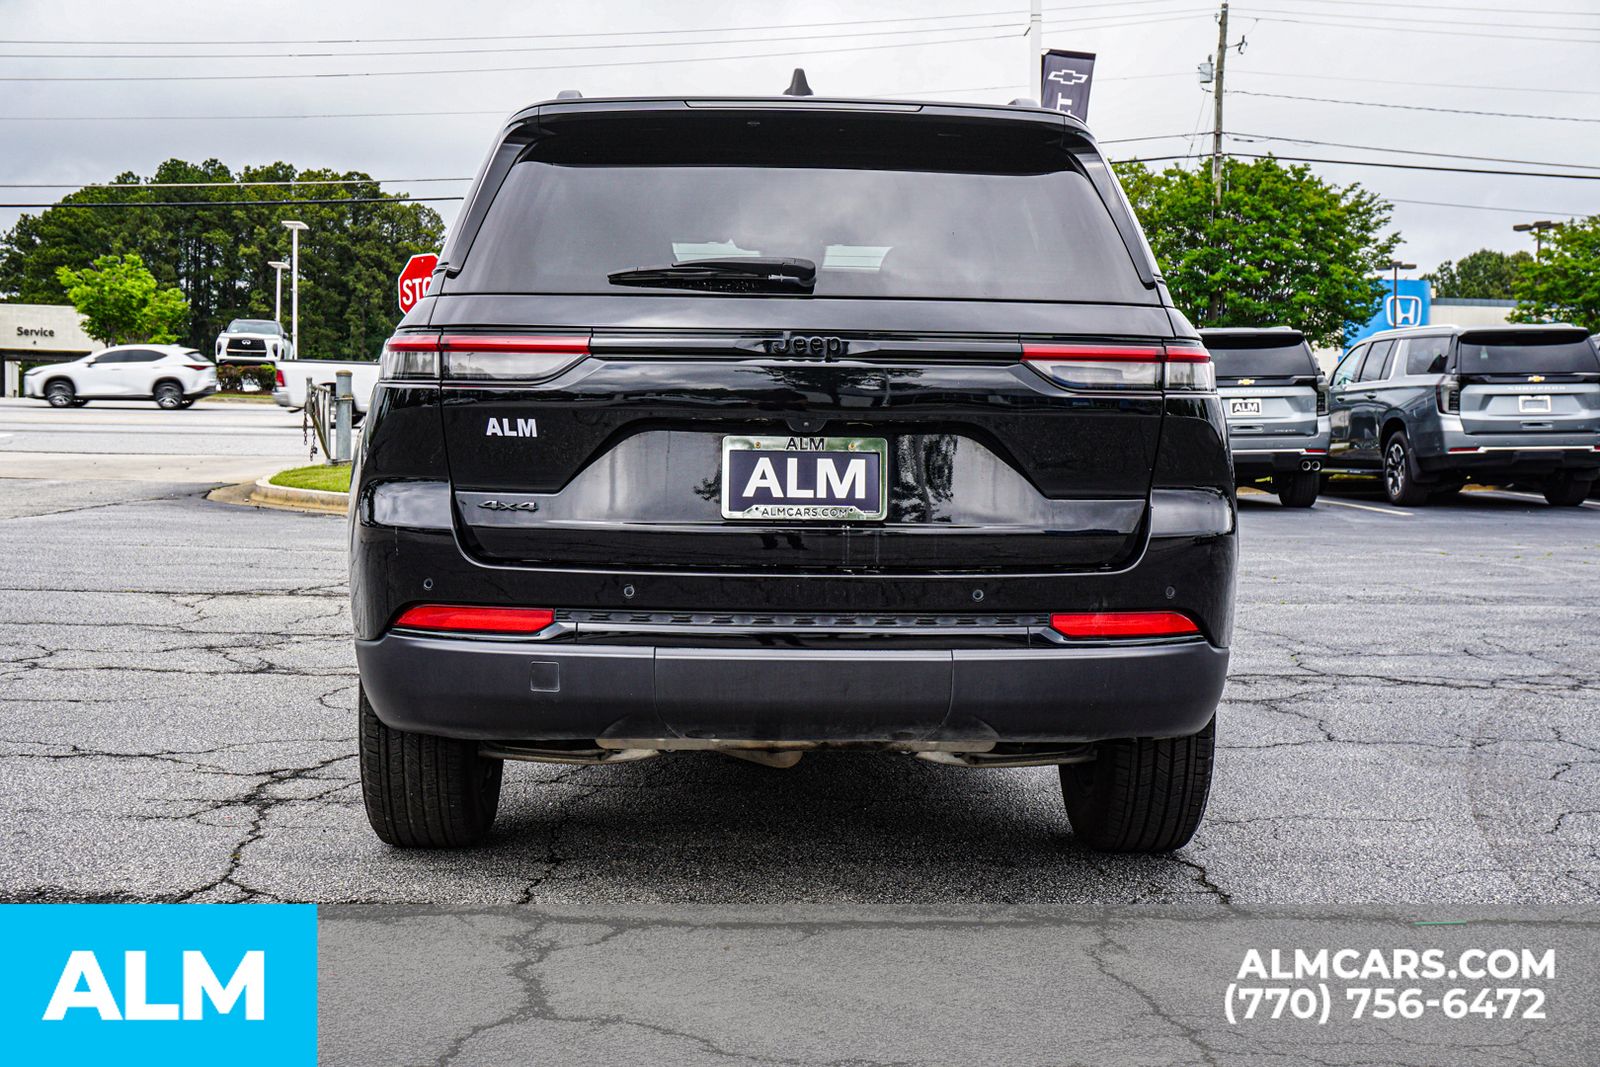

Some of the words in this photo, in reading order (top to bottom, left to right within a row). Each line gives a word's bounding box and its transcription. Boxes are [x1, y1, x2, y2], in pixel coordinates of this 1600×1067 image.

[16, 326, 55, 337] Service
[772, 330, 840, 363] Jeep
[1234, 402, 1258, 412] ALM
[486, 417, 538, 438] ALM
[786, 437, 825, 450] ALM
[742, 457, 866, 499] ALM
[761, 507, 849, 517] ALMCARS.COM
